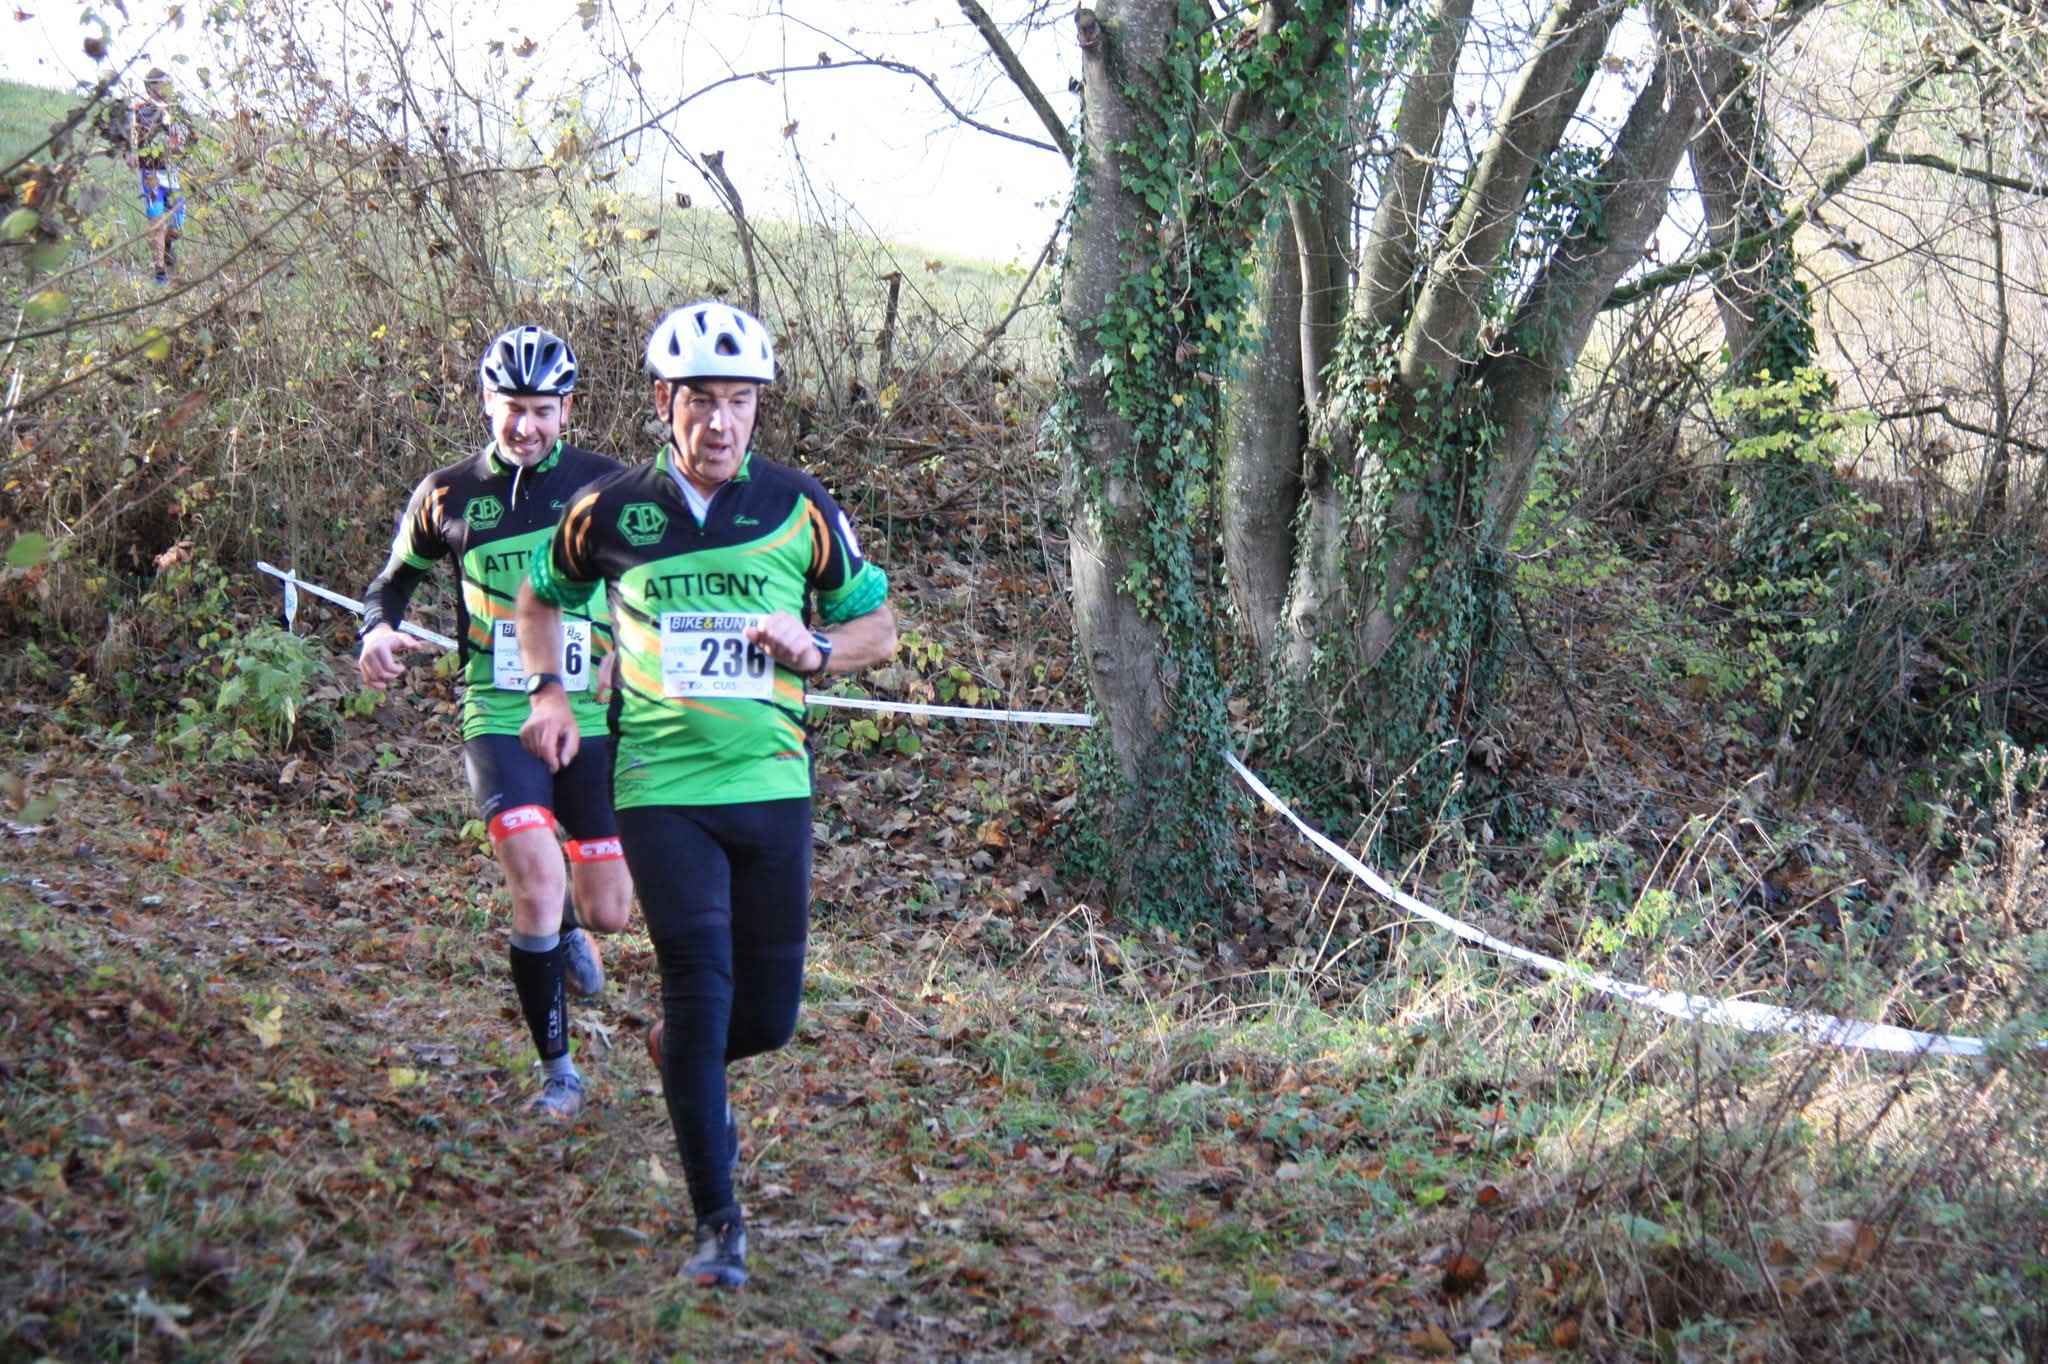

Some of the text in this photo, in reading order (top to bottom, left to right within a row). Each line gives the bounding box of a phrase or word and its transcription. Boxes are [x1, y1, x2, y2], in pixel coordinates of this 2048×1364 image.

[643, 572, 769, 601] ATTIGNY
[565, 642, 583, 676] 6
[700, 637, 767, 679] 236
